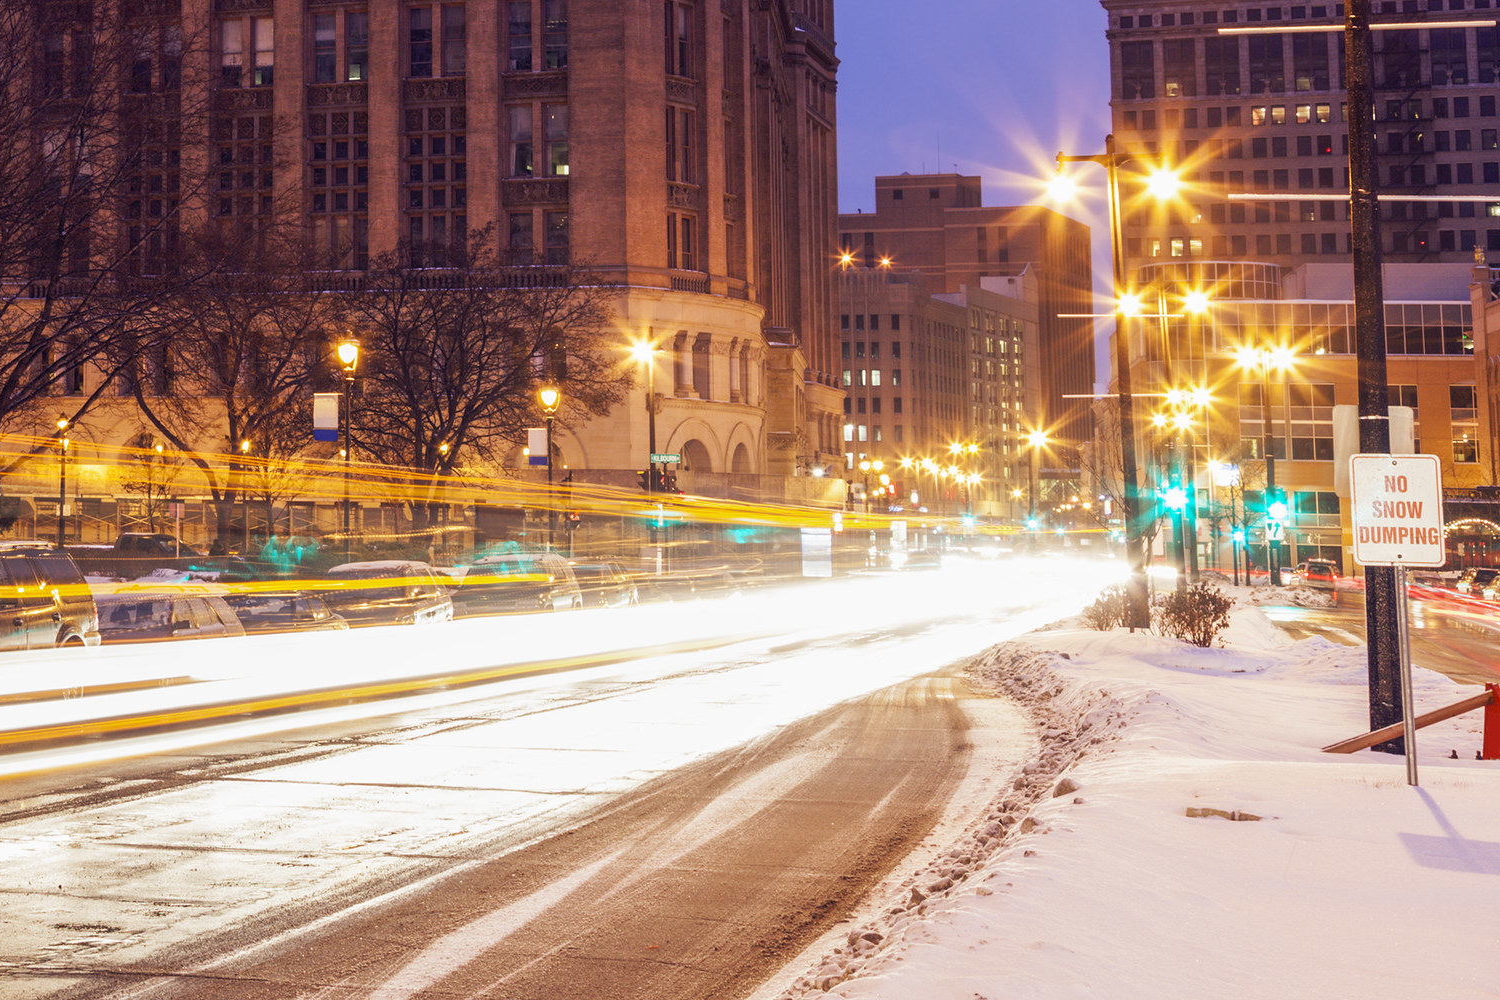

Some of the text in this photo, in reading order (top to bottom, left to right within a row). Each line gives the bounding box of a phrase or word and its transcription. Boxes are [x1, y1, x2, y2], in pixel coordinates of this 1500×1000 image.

[1384, 475, 1408, 493] NO
[1372, 500, 1423, 519] SNOW
[1359, 526, 1439, 545] DUMPING
